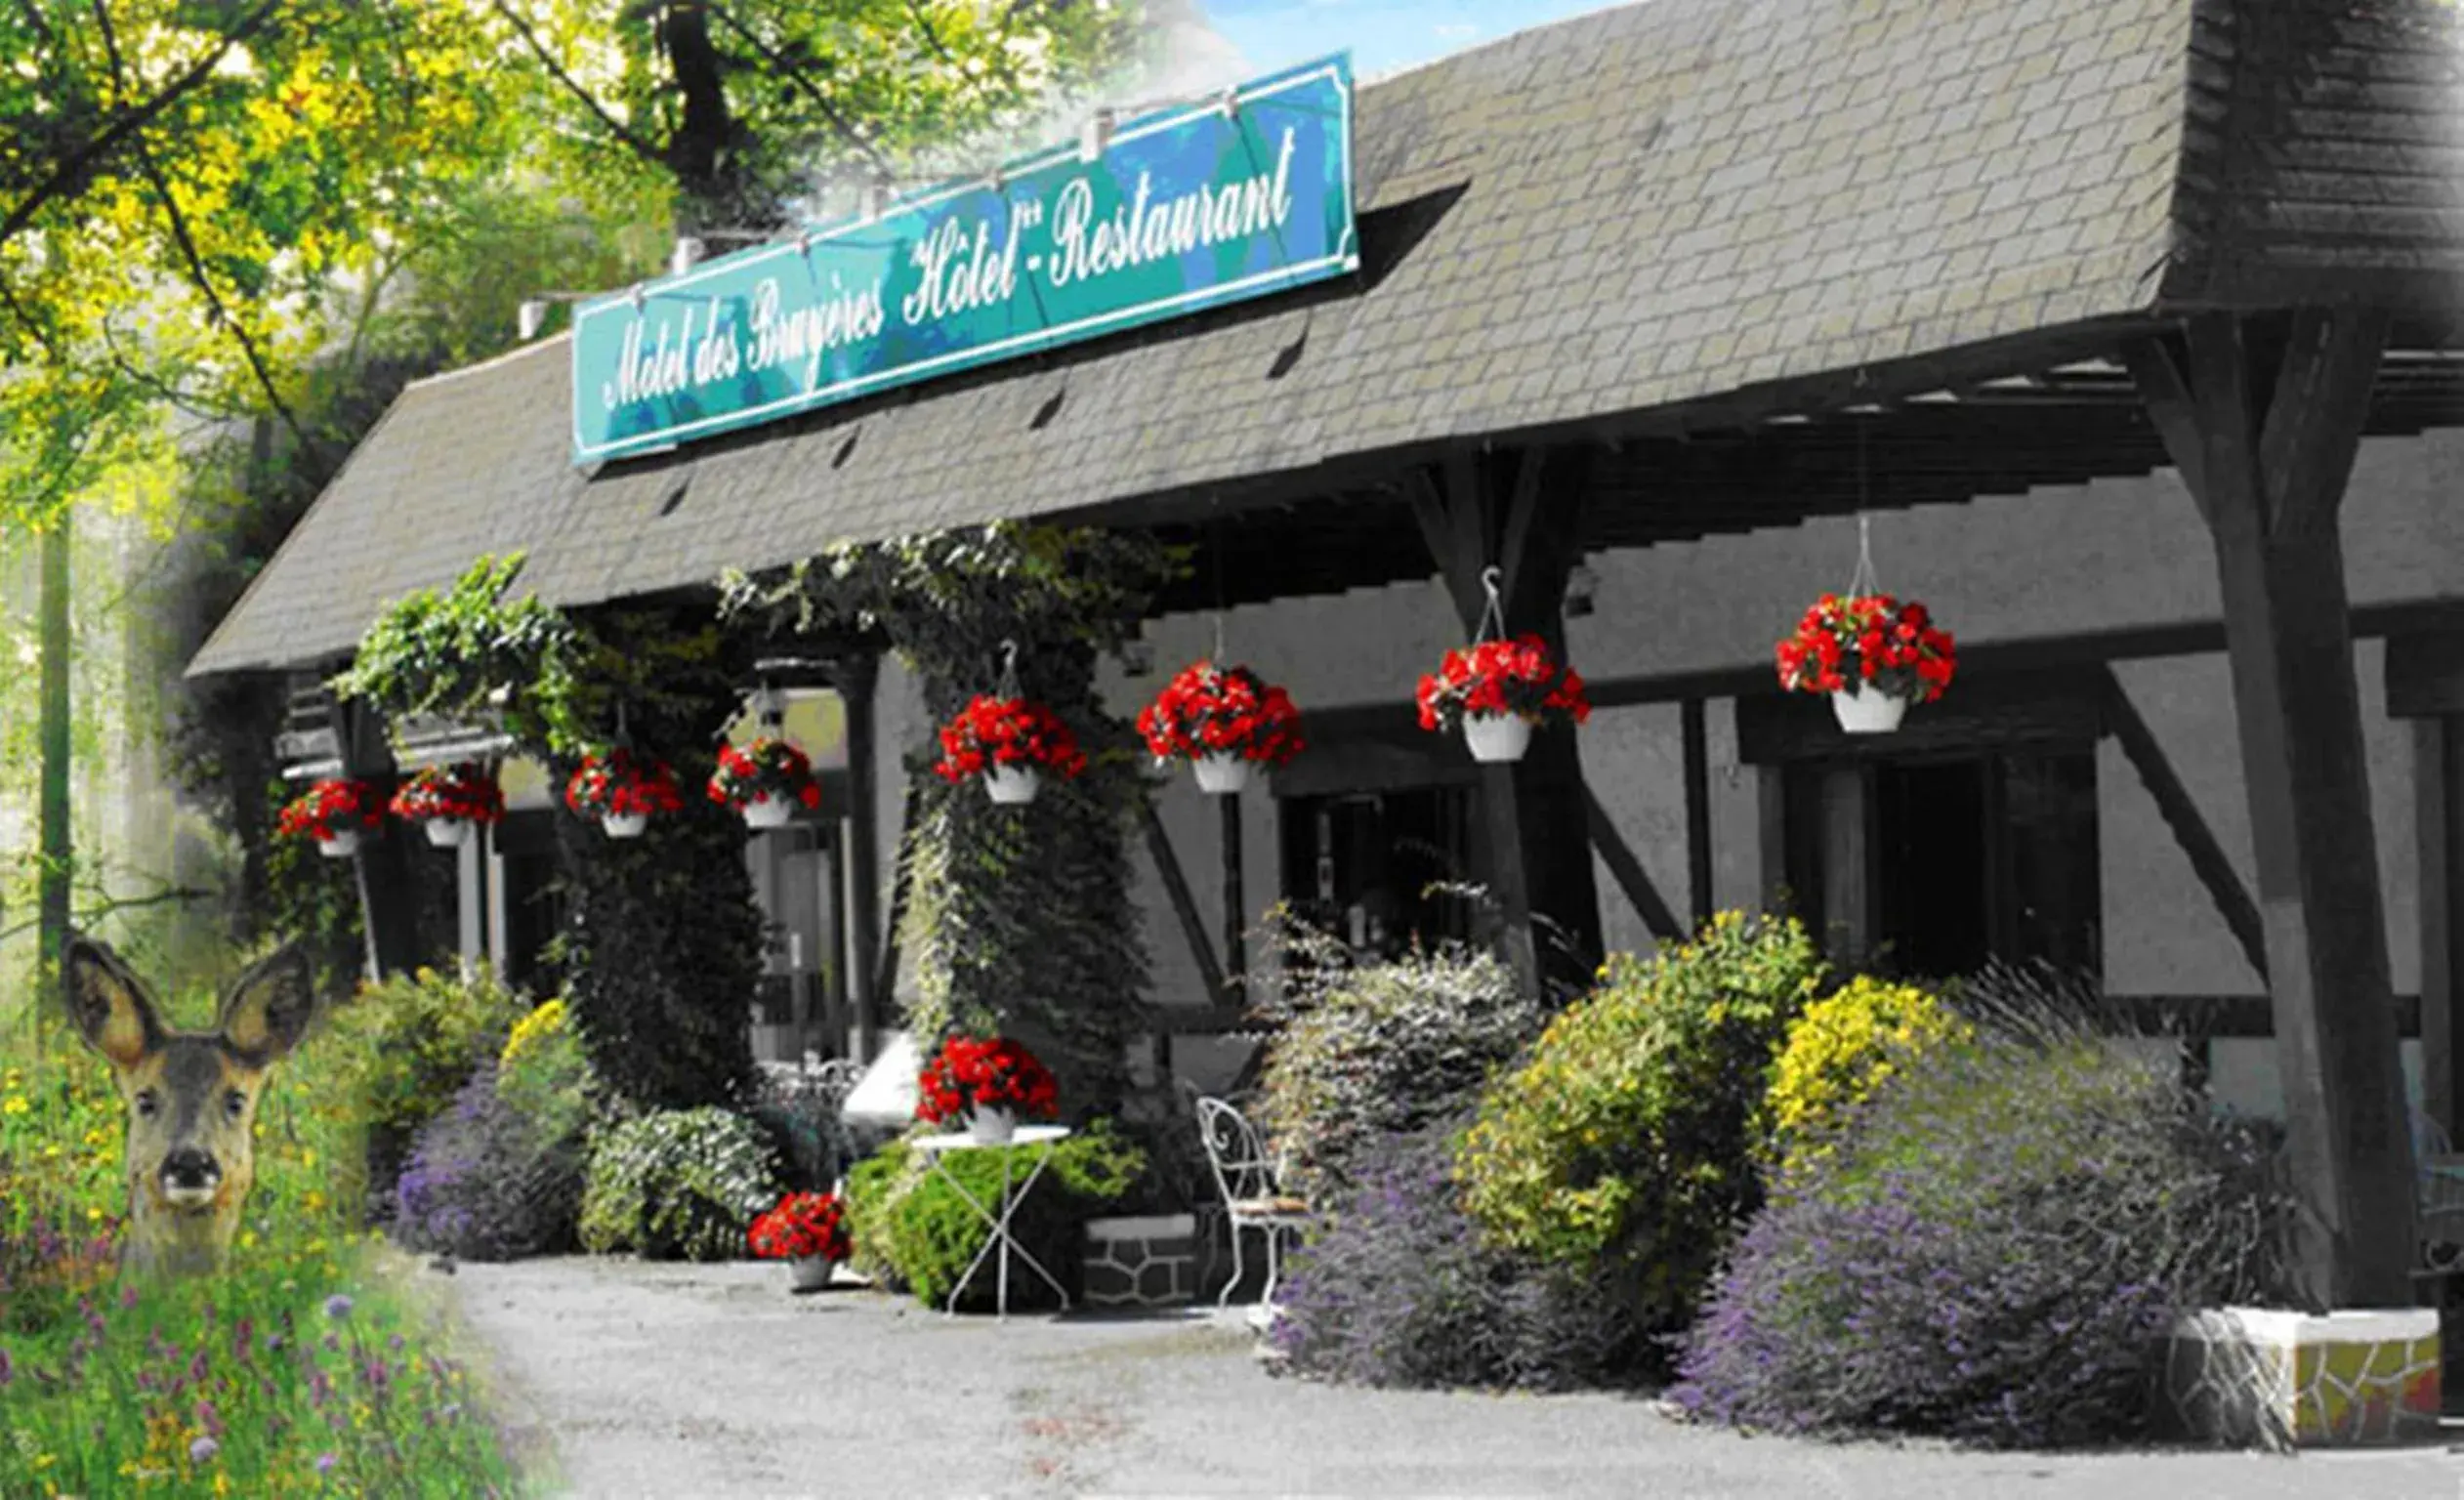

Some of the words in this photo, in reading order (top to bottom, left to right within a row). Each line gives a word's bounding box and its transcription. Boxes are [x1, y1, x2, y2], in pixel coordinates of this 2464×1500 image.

[602, 305, 693, 408] Motel
[694, 297, 739, 384] des
[1050, 126, 1295, 286] Restaurant
